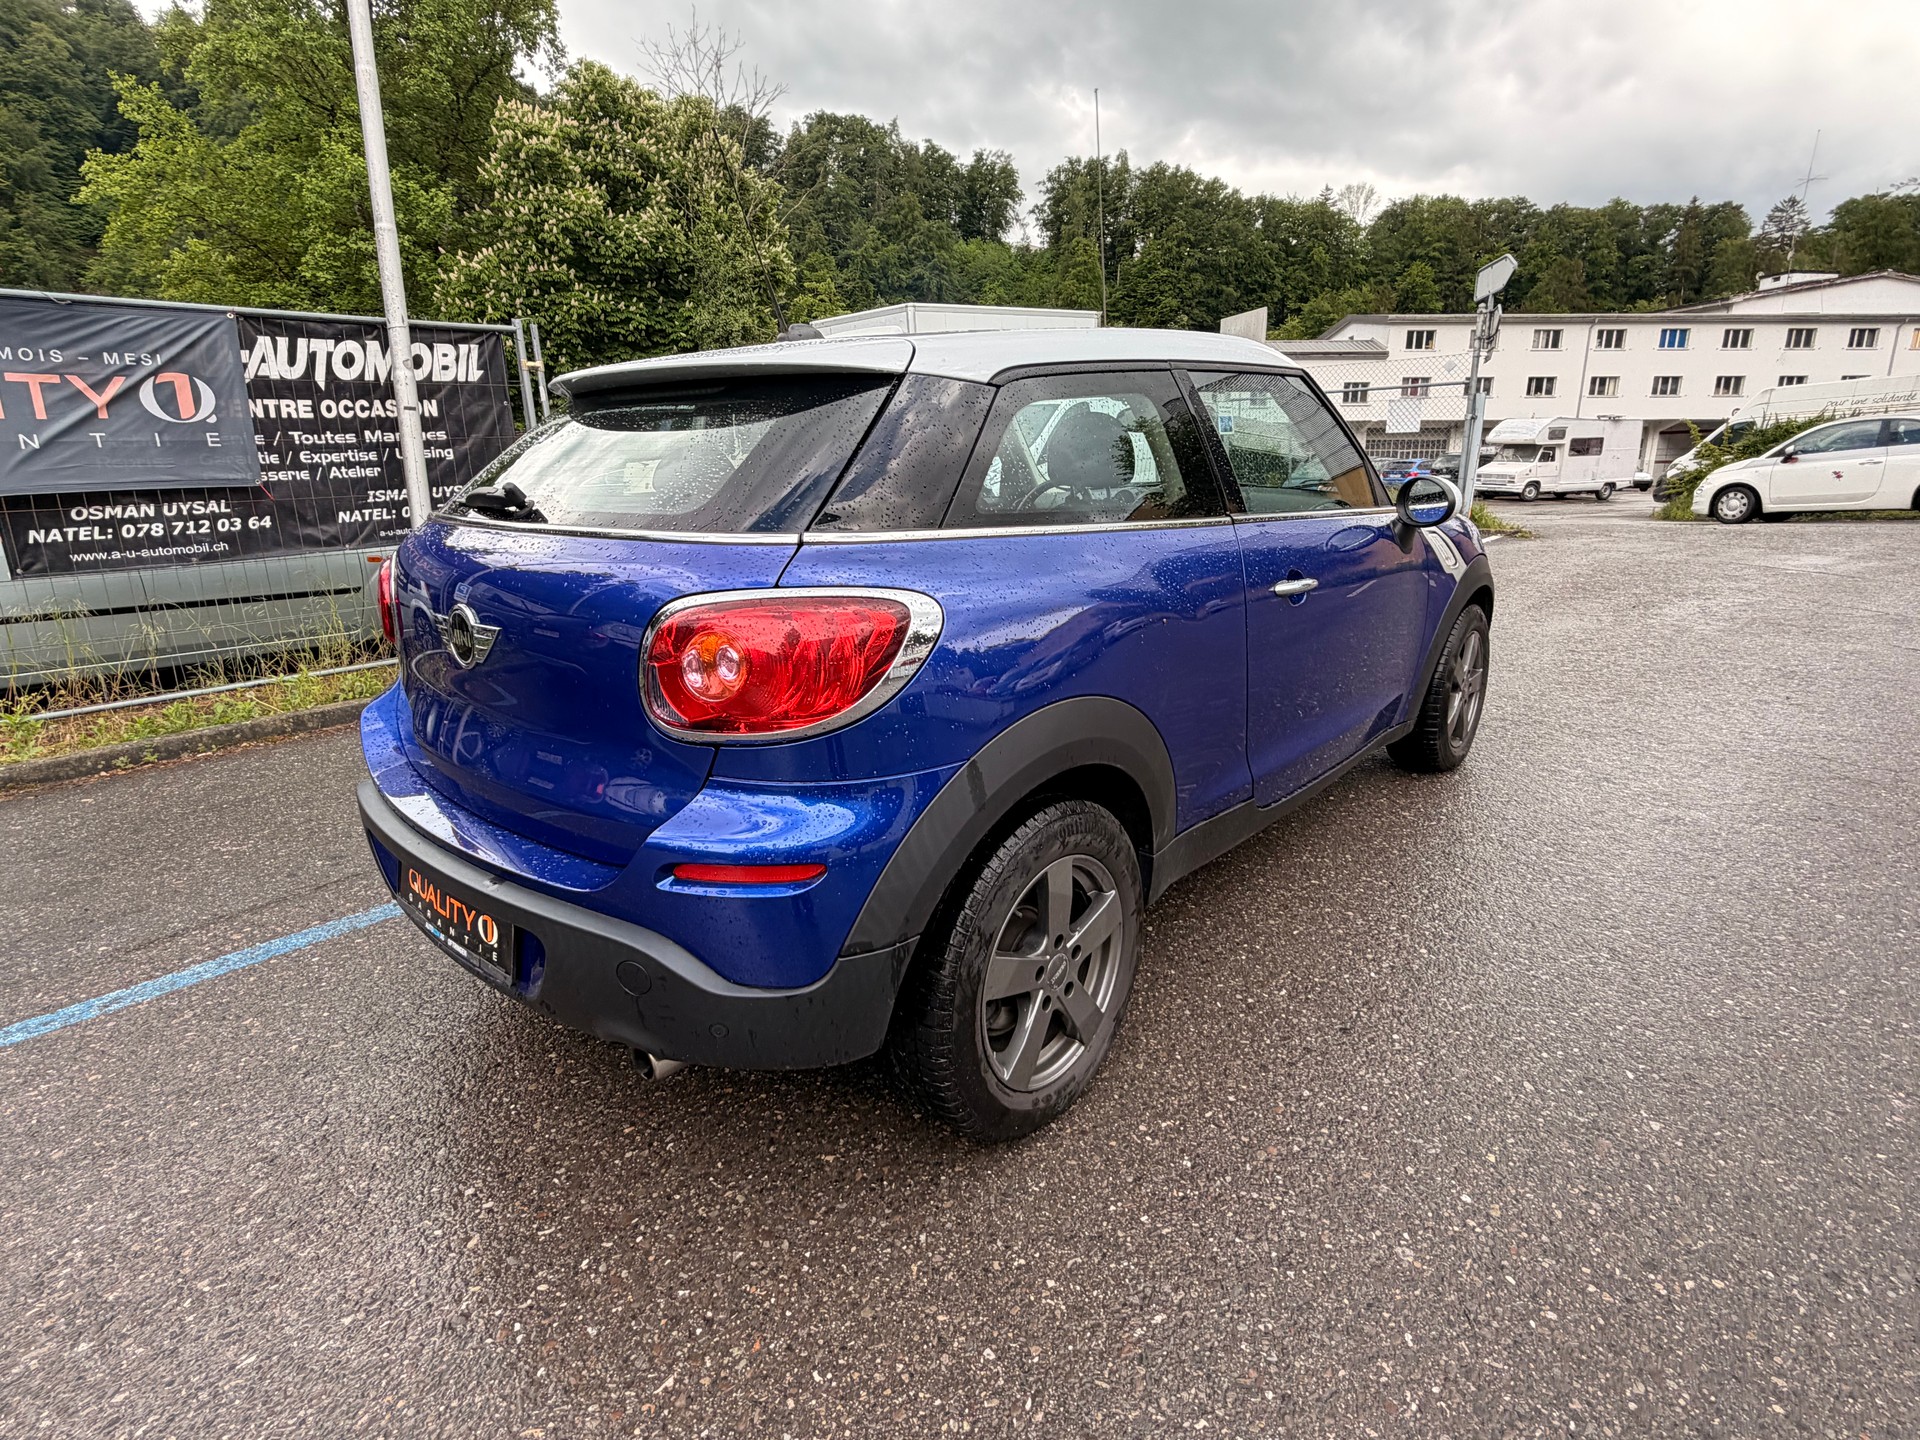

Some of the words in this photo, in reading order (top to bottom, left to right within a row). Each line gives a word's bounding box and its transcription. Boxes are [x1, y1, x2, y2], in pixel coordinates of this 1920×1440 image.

[103, 351, 162, 365] MESI
[248, 399, 314, 419] NTRE
[320, 399, 439, 419] OCCASN
[288, 430, 357, 446] Toutes
[299, 449, 378, 466] Expertise
[395, 446, 454, 460] Lsing
[329, 465, 381, 480] Atelier
[367, 489, 408, 502] ISMA
[70, 501, 155, 521] OSMAN
[163, 500, 231, 517] UYSAL
[338, 508, 396, 523] NATEL:
[28, 525, 113, 544] NATEL:
[121, 523, 165, 538] 078
[171, 521, 211, 536] 712
[217, 517, 242, 532] 03
[248, 515, 272, 530] 64
[69, 541, 229, 562] www.a-u-automobil.ch
[409, 868, 476, 931] QUALITY
